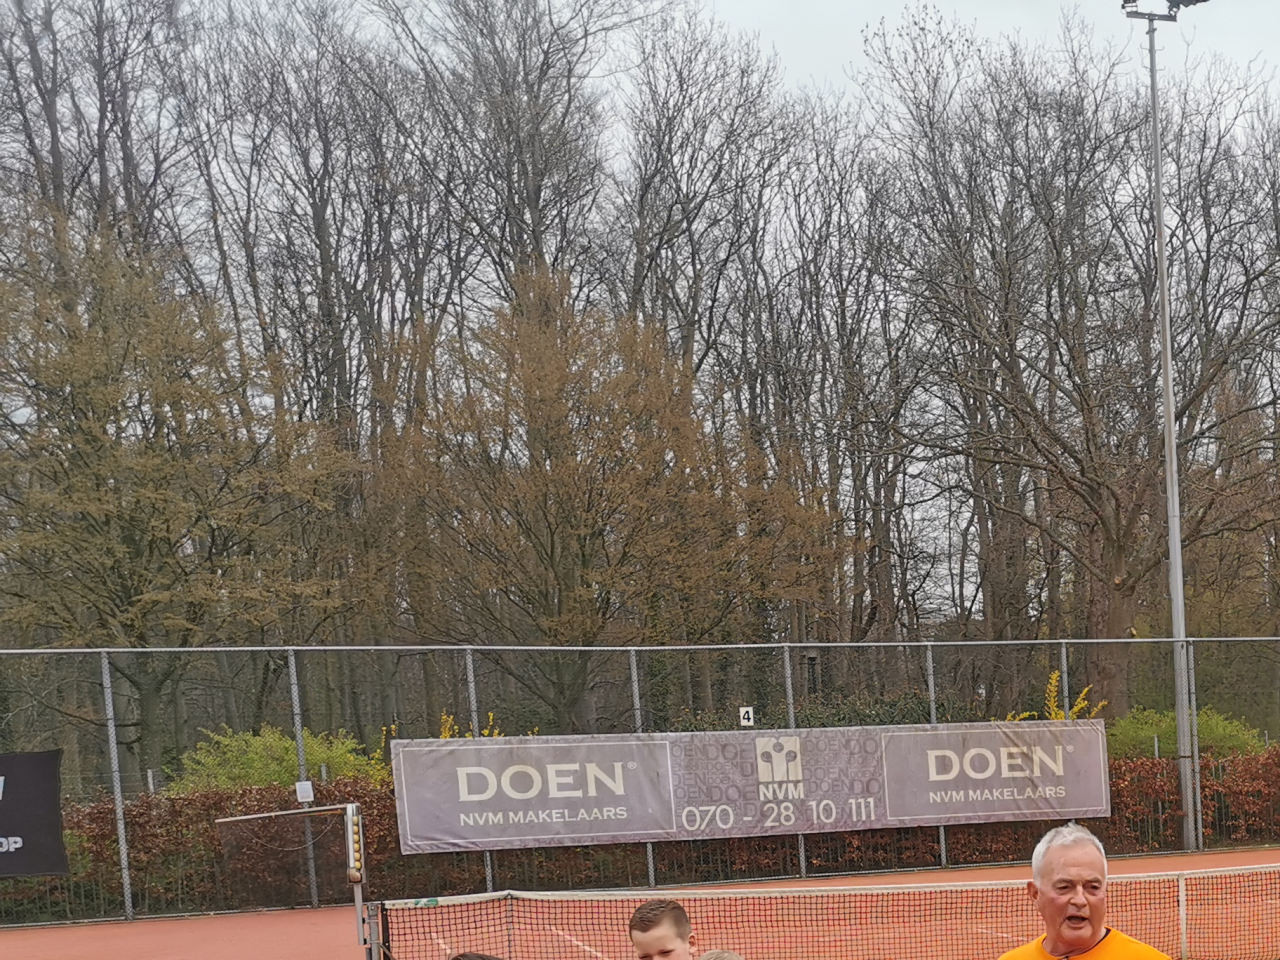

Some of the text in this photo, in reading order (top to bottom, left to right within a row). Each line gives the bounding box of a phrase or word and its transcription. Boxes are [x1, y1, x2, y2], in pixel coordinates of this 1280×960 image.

[742, 710, 751, 723] 4
[758, 782, 805, 802] NVM
[929, 785, 1066, 804] NVM MAKELAARS
[459, 806, 628, 827] NVM MAKELAARS
[681, 804, 734, 831] 070
[763, 801, 796, 827] 28
[808, 799, 837, 824] 10
[848, 797, 875, 822] 111
